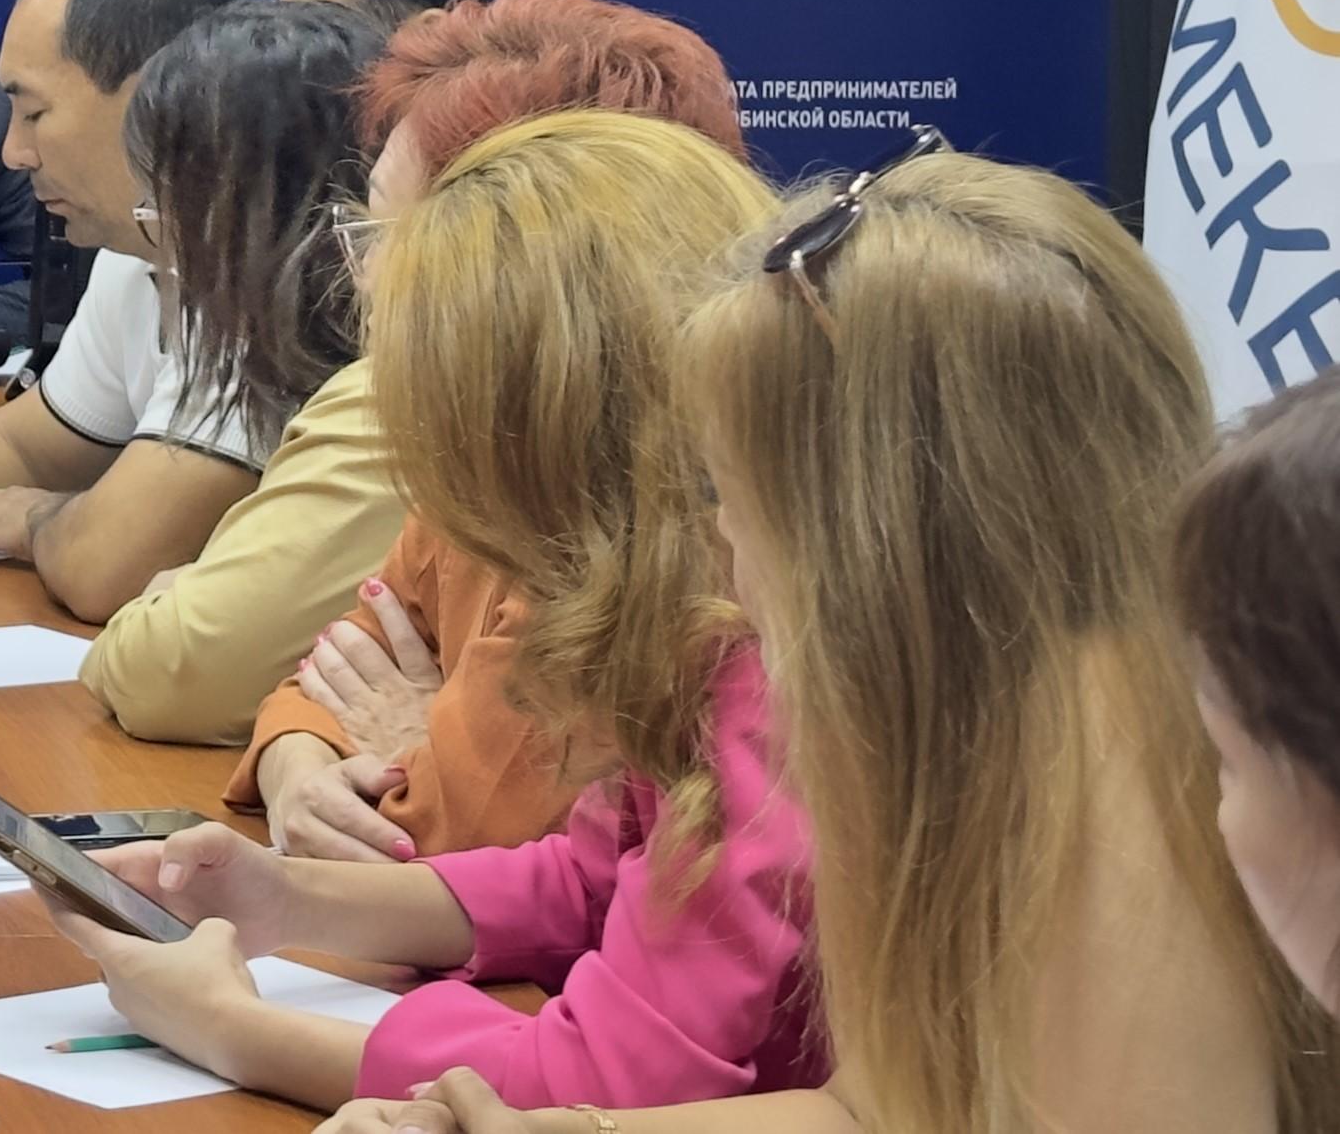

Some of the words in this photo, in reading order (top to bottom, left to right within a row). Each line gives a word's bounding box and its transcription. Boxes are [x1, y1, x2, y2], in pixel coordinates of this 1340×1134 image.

[762, 77, 957, 102] ПРЕДПРИНИМАТЕЛЕЙ
[736, 106, 824, 129] БИНСКОЙ
[828, 110, 910, 129] ОБЛАСТИ
